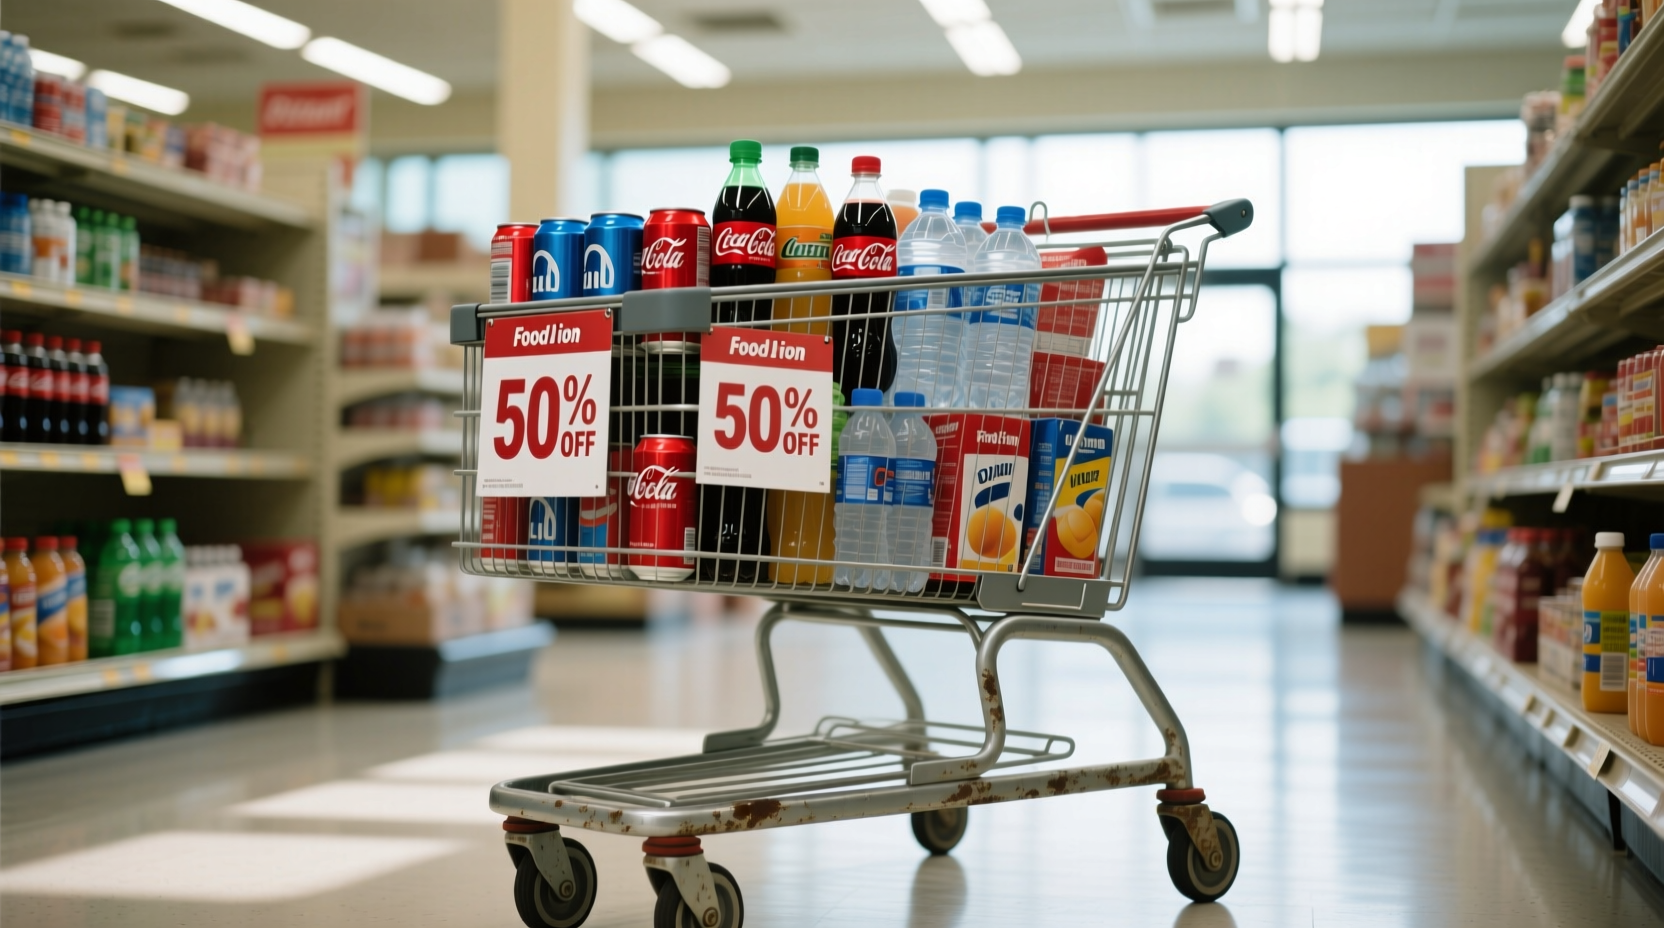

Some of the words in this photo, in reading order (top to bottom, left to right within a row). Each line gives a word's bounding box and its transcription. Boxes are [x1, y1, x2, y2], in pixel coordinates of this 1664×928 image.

[493, 373, 597, 460] 50%
[714, 382, 818, 453] 50%
[560, 430, 597, 458] OFF
[782, 431, 820, 456] OFF
